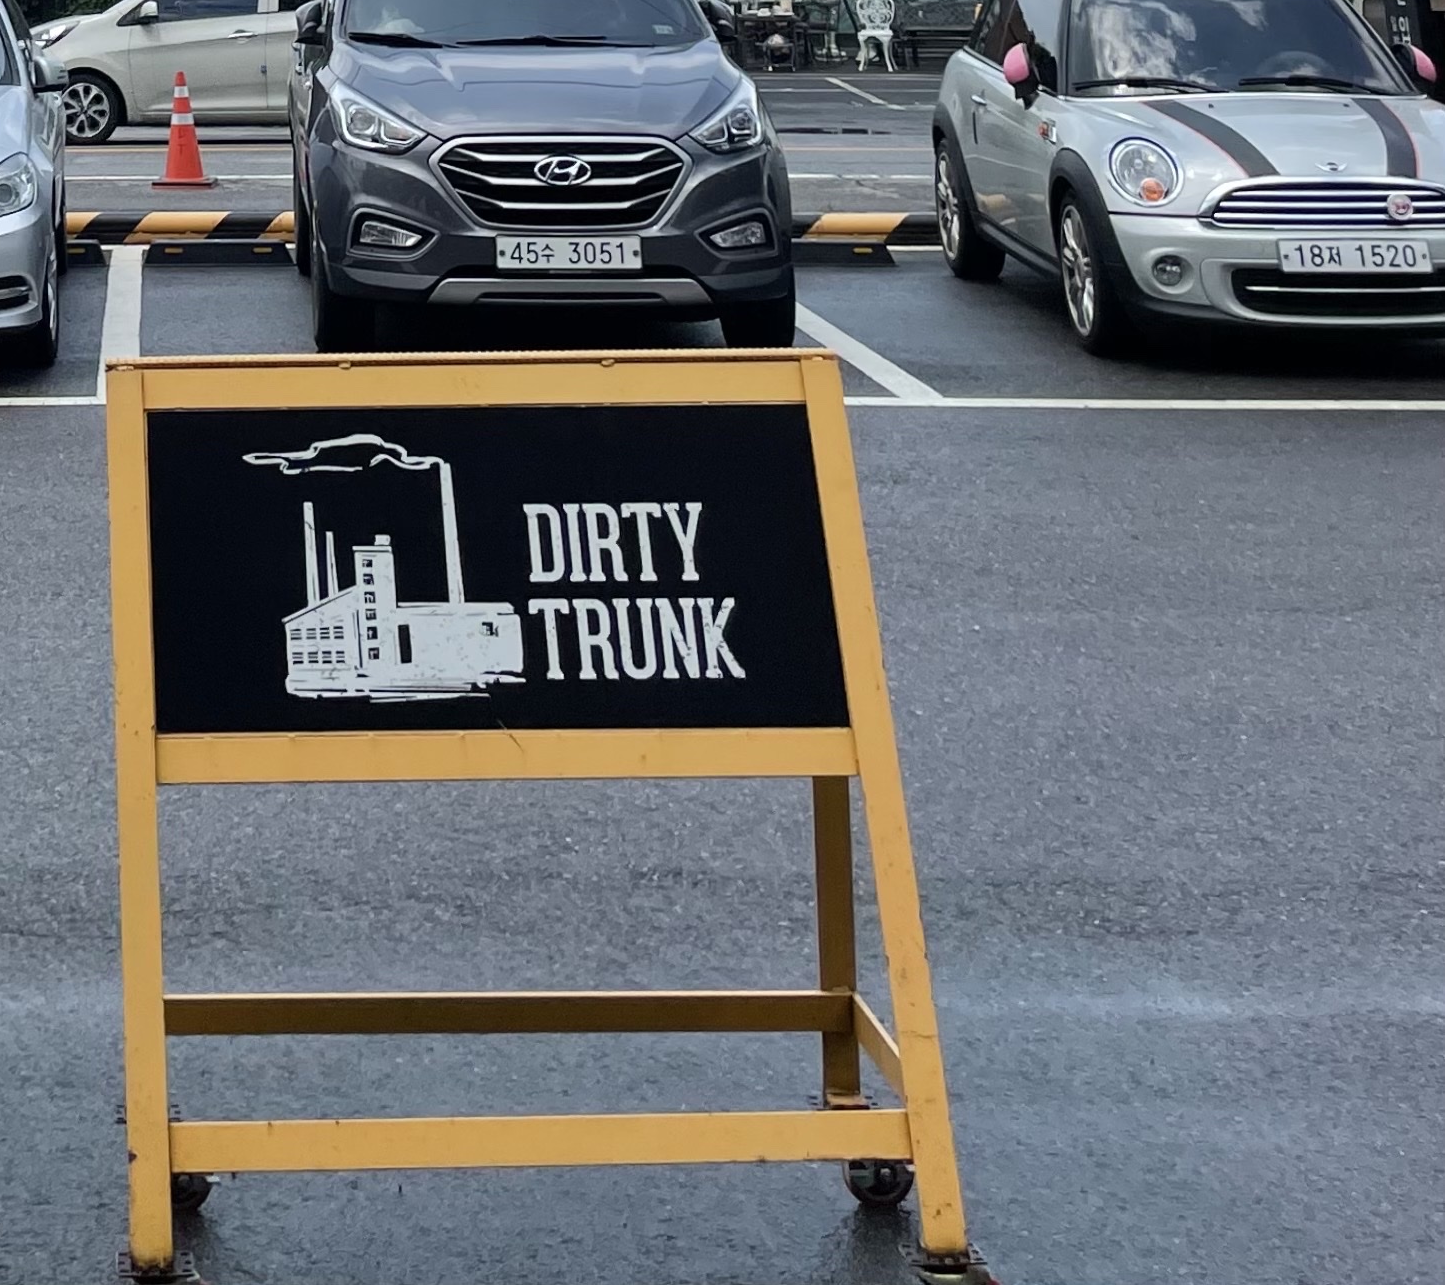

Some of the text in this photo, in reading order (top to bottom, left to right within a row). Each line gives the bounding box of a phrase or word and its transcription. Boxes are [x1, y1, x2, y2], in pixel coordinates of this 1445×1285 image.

[510, 242, 626, 265] 45수 3051
[1294, 244, 1418, 268] 18저 1520
[522, 502, 703, 582] DIRTY
[528, 597, 747, 680] TRUNK
